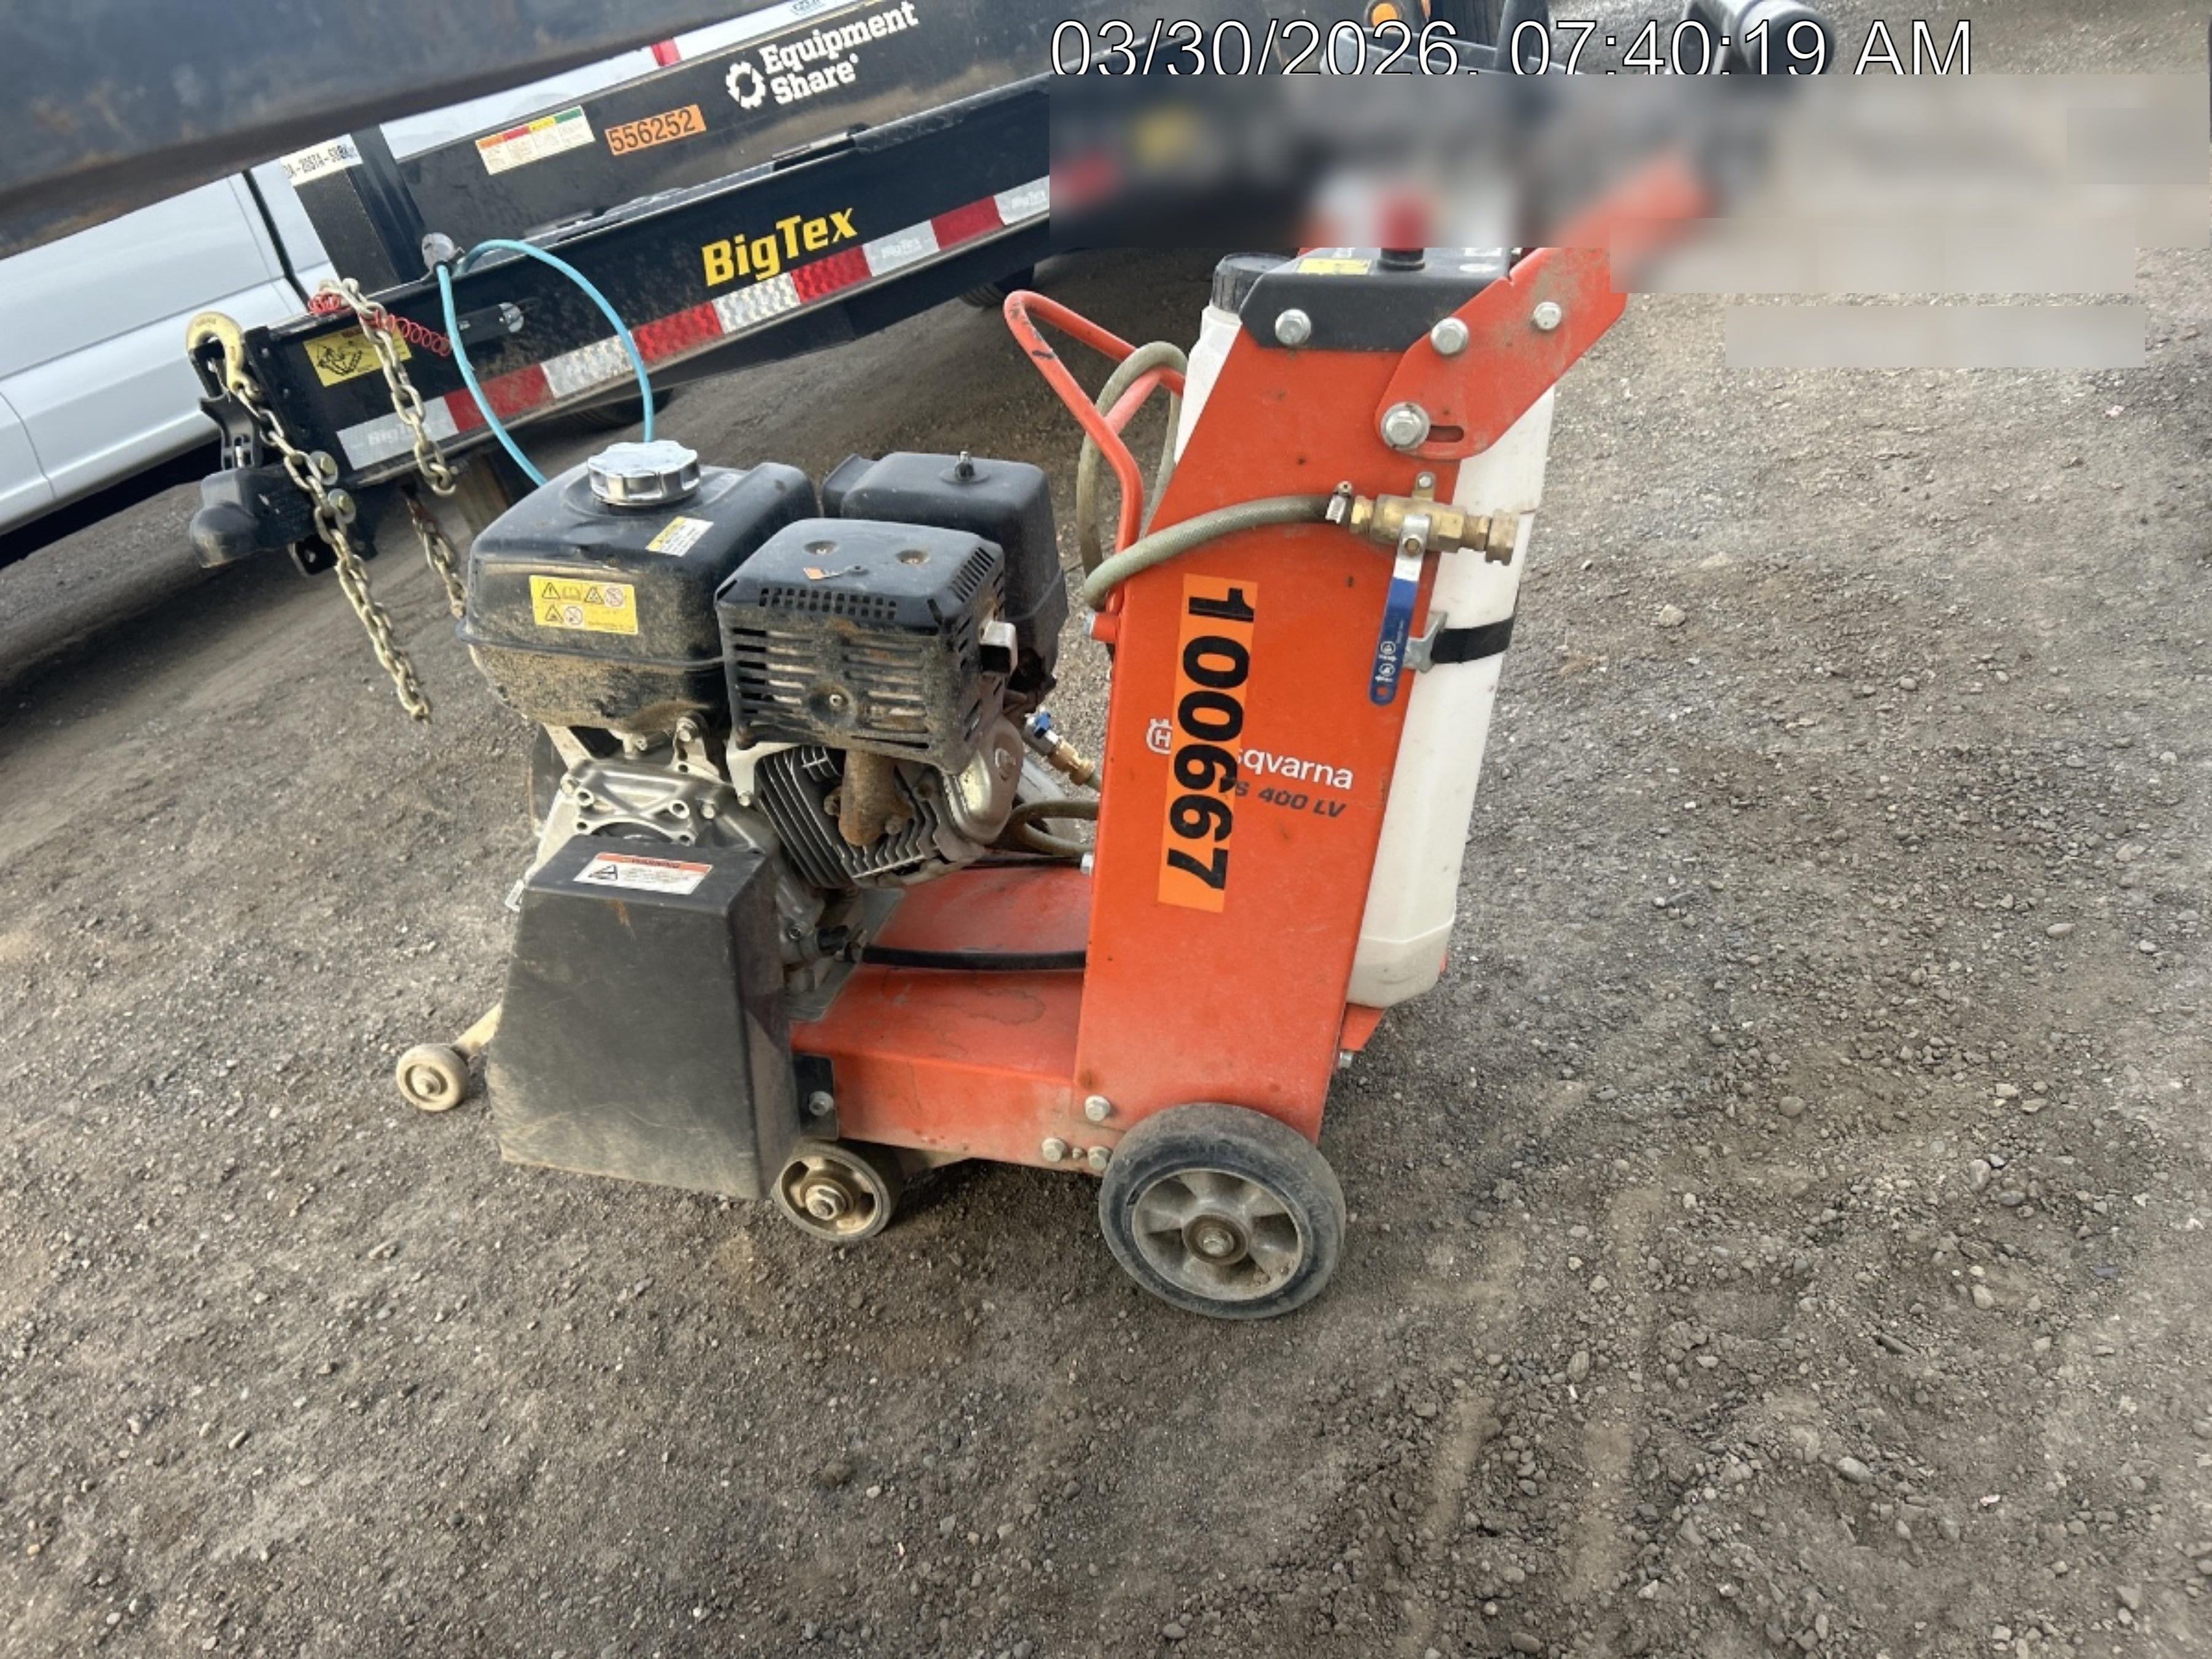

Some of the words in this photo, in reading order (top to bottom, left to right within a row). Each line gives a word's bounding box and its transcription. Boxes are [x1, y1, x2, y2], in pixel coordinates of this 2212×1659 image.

[758, 1, 919, 74] Equipment
[770, 59, 857, 105] Share
[608, 108, 696, 152] 556252
[701, 207, 858, 288] BigTex
[1167, 587, 1255, 891] 100667
[1258, 787, 1308, 810] 400
[1313, 799, 1346, 818] LV
